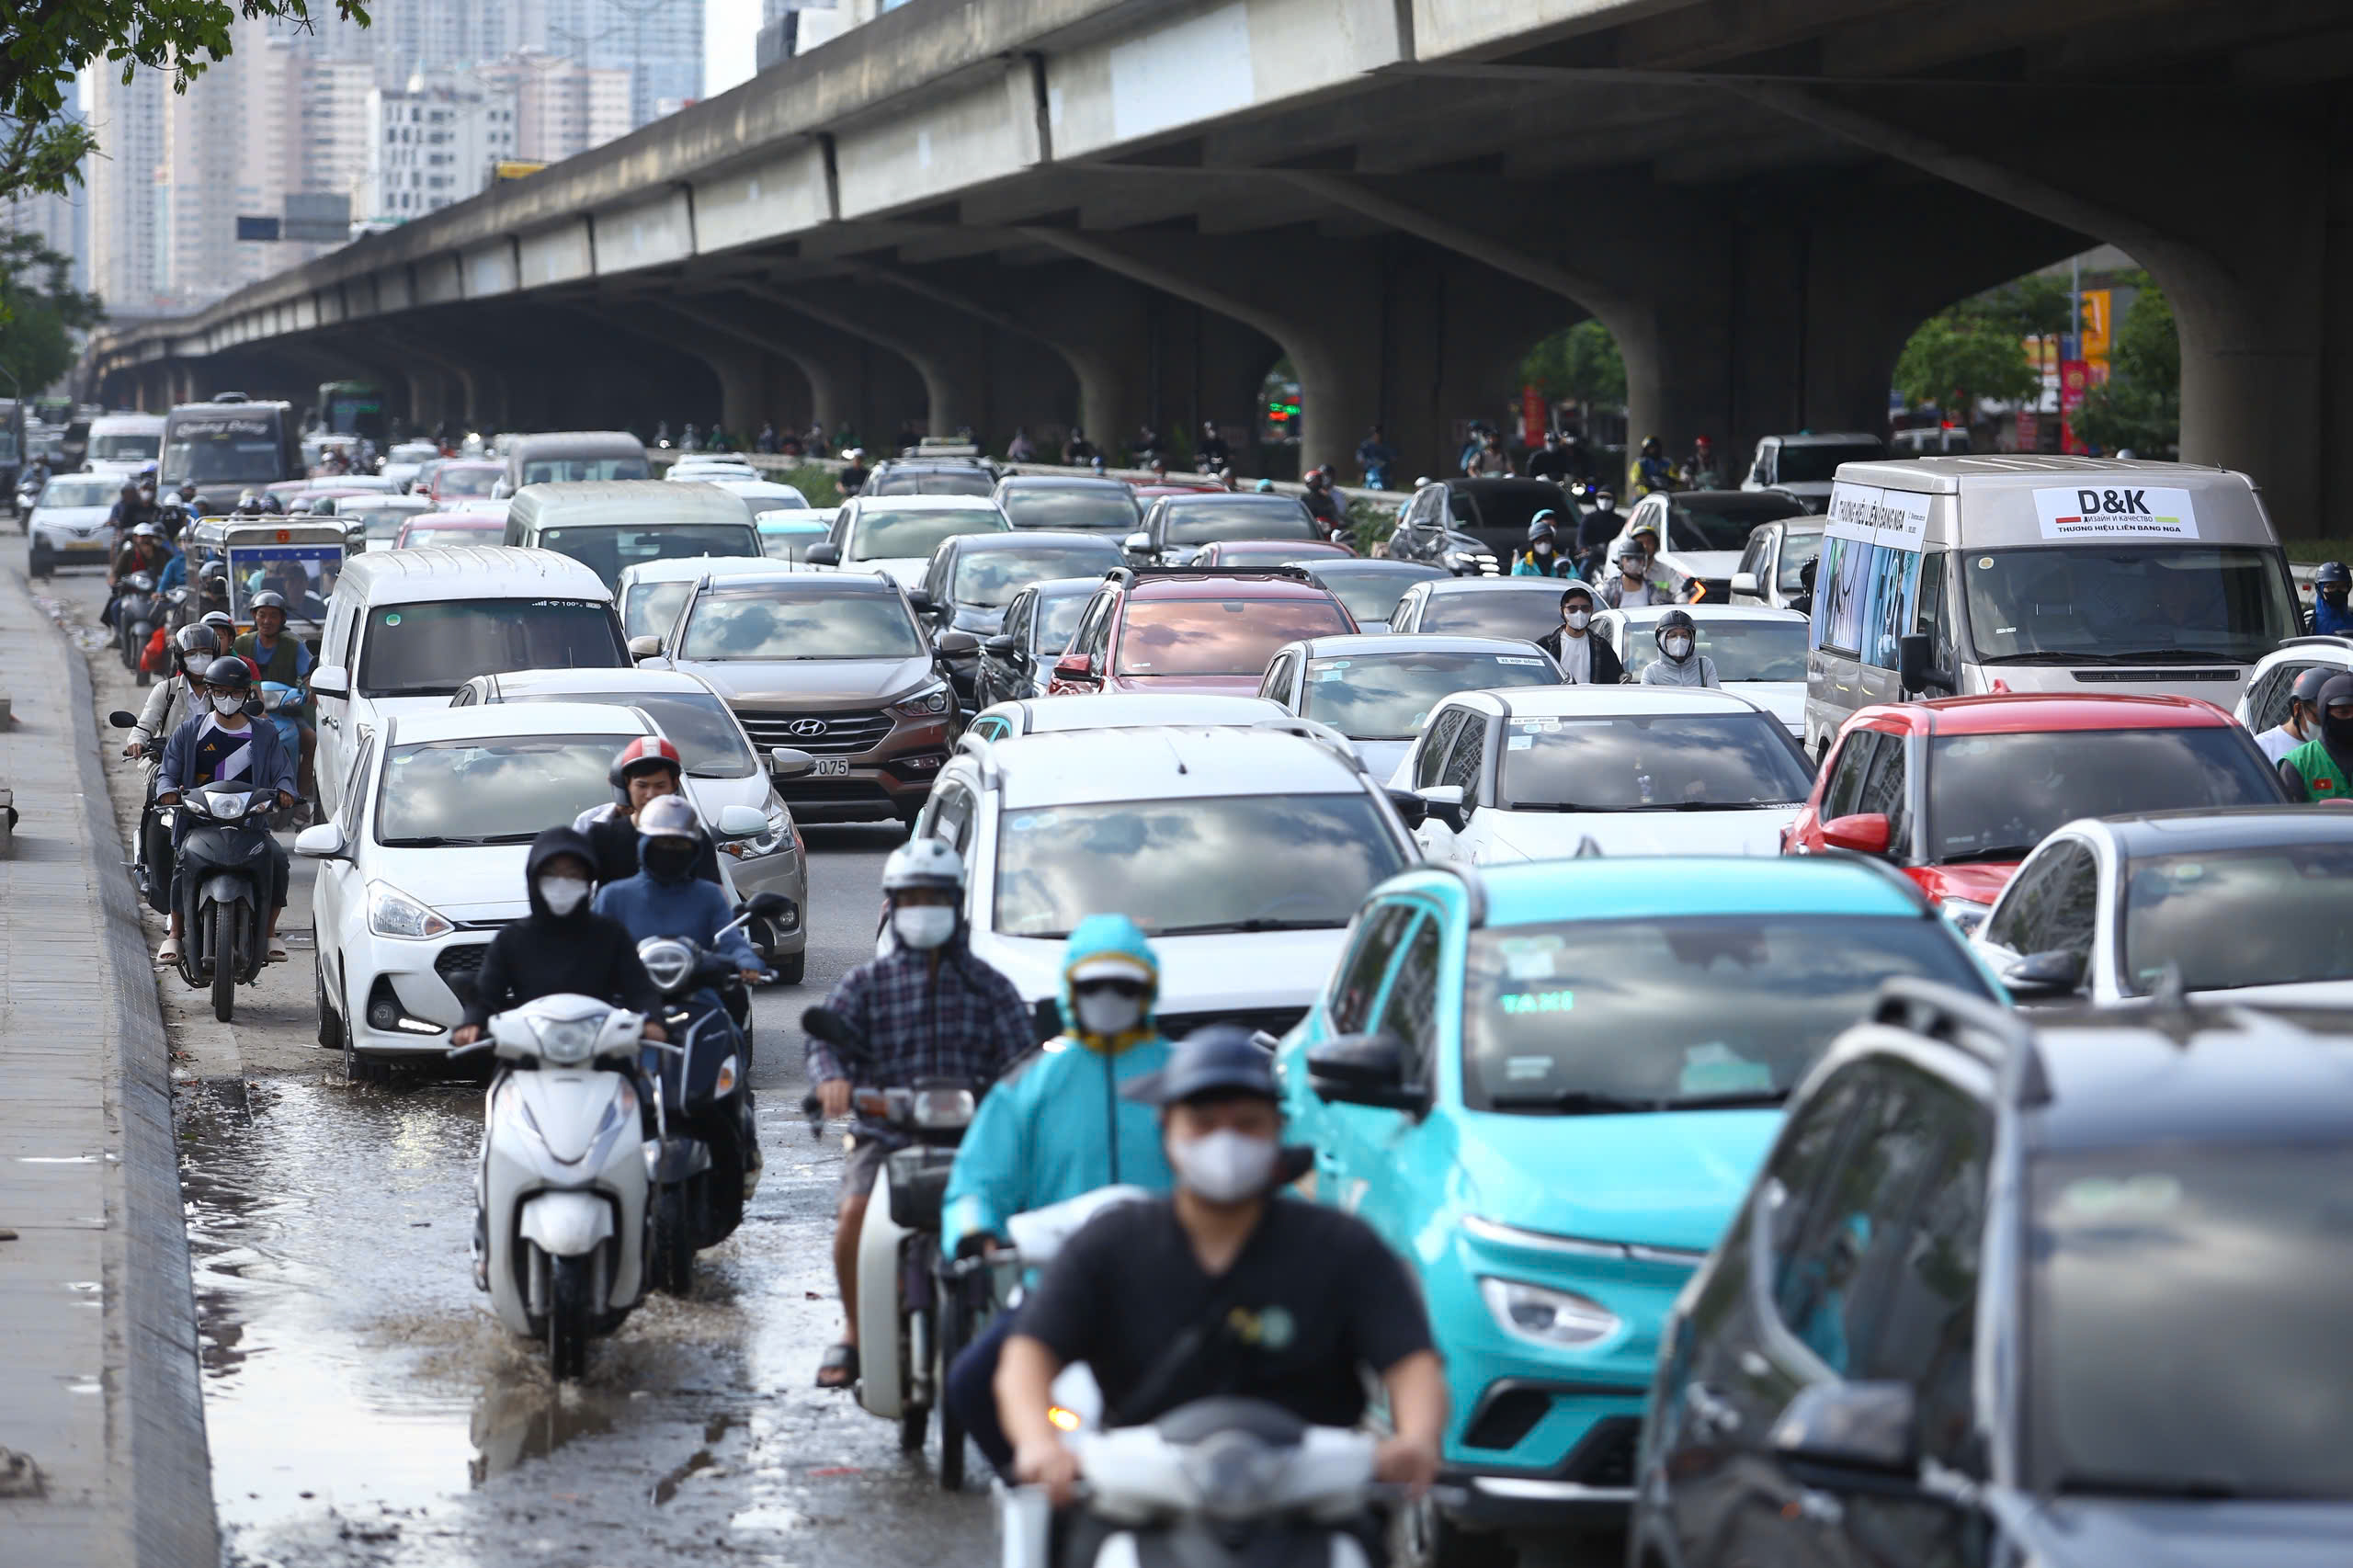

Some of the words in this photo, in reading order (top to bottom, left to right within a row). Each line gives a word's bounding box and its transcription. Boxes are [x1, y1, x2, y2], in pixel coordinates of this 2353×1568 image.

[2077, 489, 2151, 515] D&K
[2084, 514, 2111, 523] дизайн
[2120, 515, 2154, 523] качество
[2057, 525, 2094, 533] THƯƠNG
[2095, 524, 2115, 532] HIỆU
[2116, 523, 2136, 531] LIÊN
[1500, 990, 1574, 1014] TAXI
